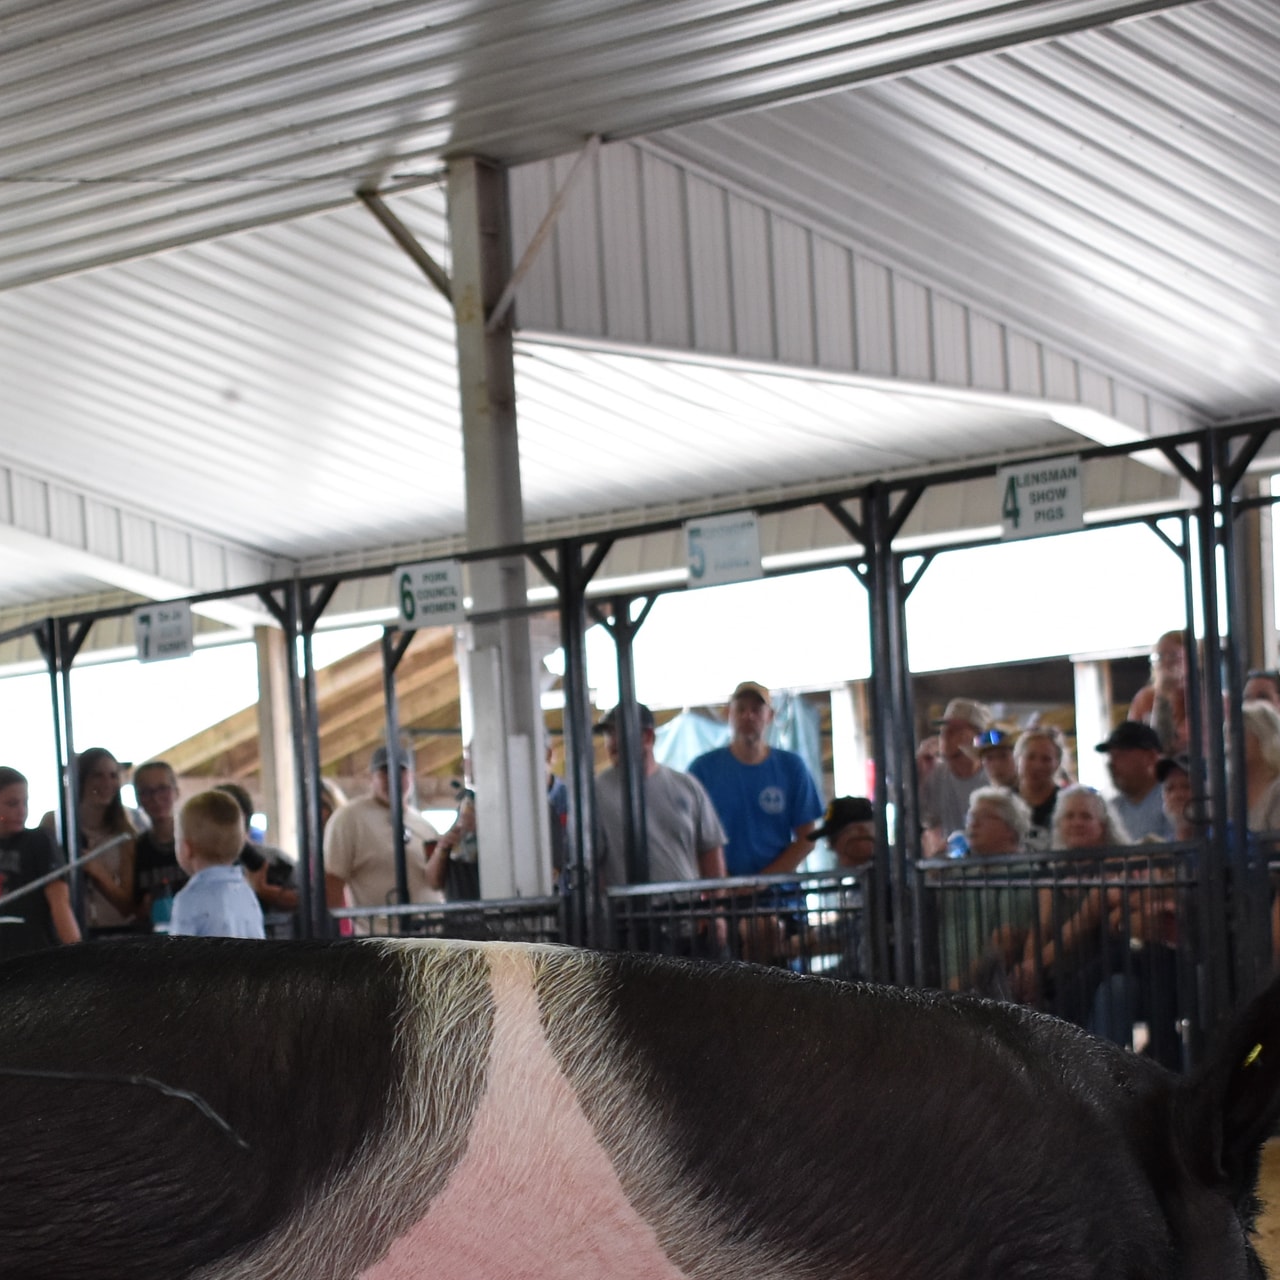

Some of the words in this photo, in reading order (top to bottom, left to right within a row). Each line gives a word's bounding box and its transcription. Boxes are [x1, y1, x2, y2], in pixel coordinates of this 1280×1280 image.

[1002, 475, 1020, 529] 4
[1029, 487, 1068, 505] SHOW
[1034, 506, 1064, 522] PIGS
[688, 528, 705, 579] 5
[422, 570, 448, 584] PORK
[400, 572, 416, 622] 6
[416, 585, 458, 602] COUNCIL
[421, 601, 457, 616] WOMEN
[138, 613, 152, 659] 7
